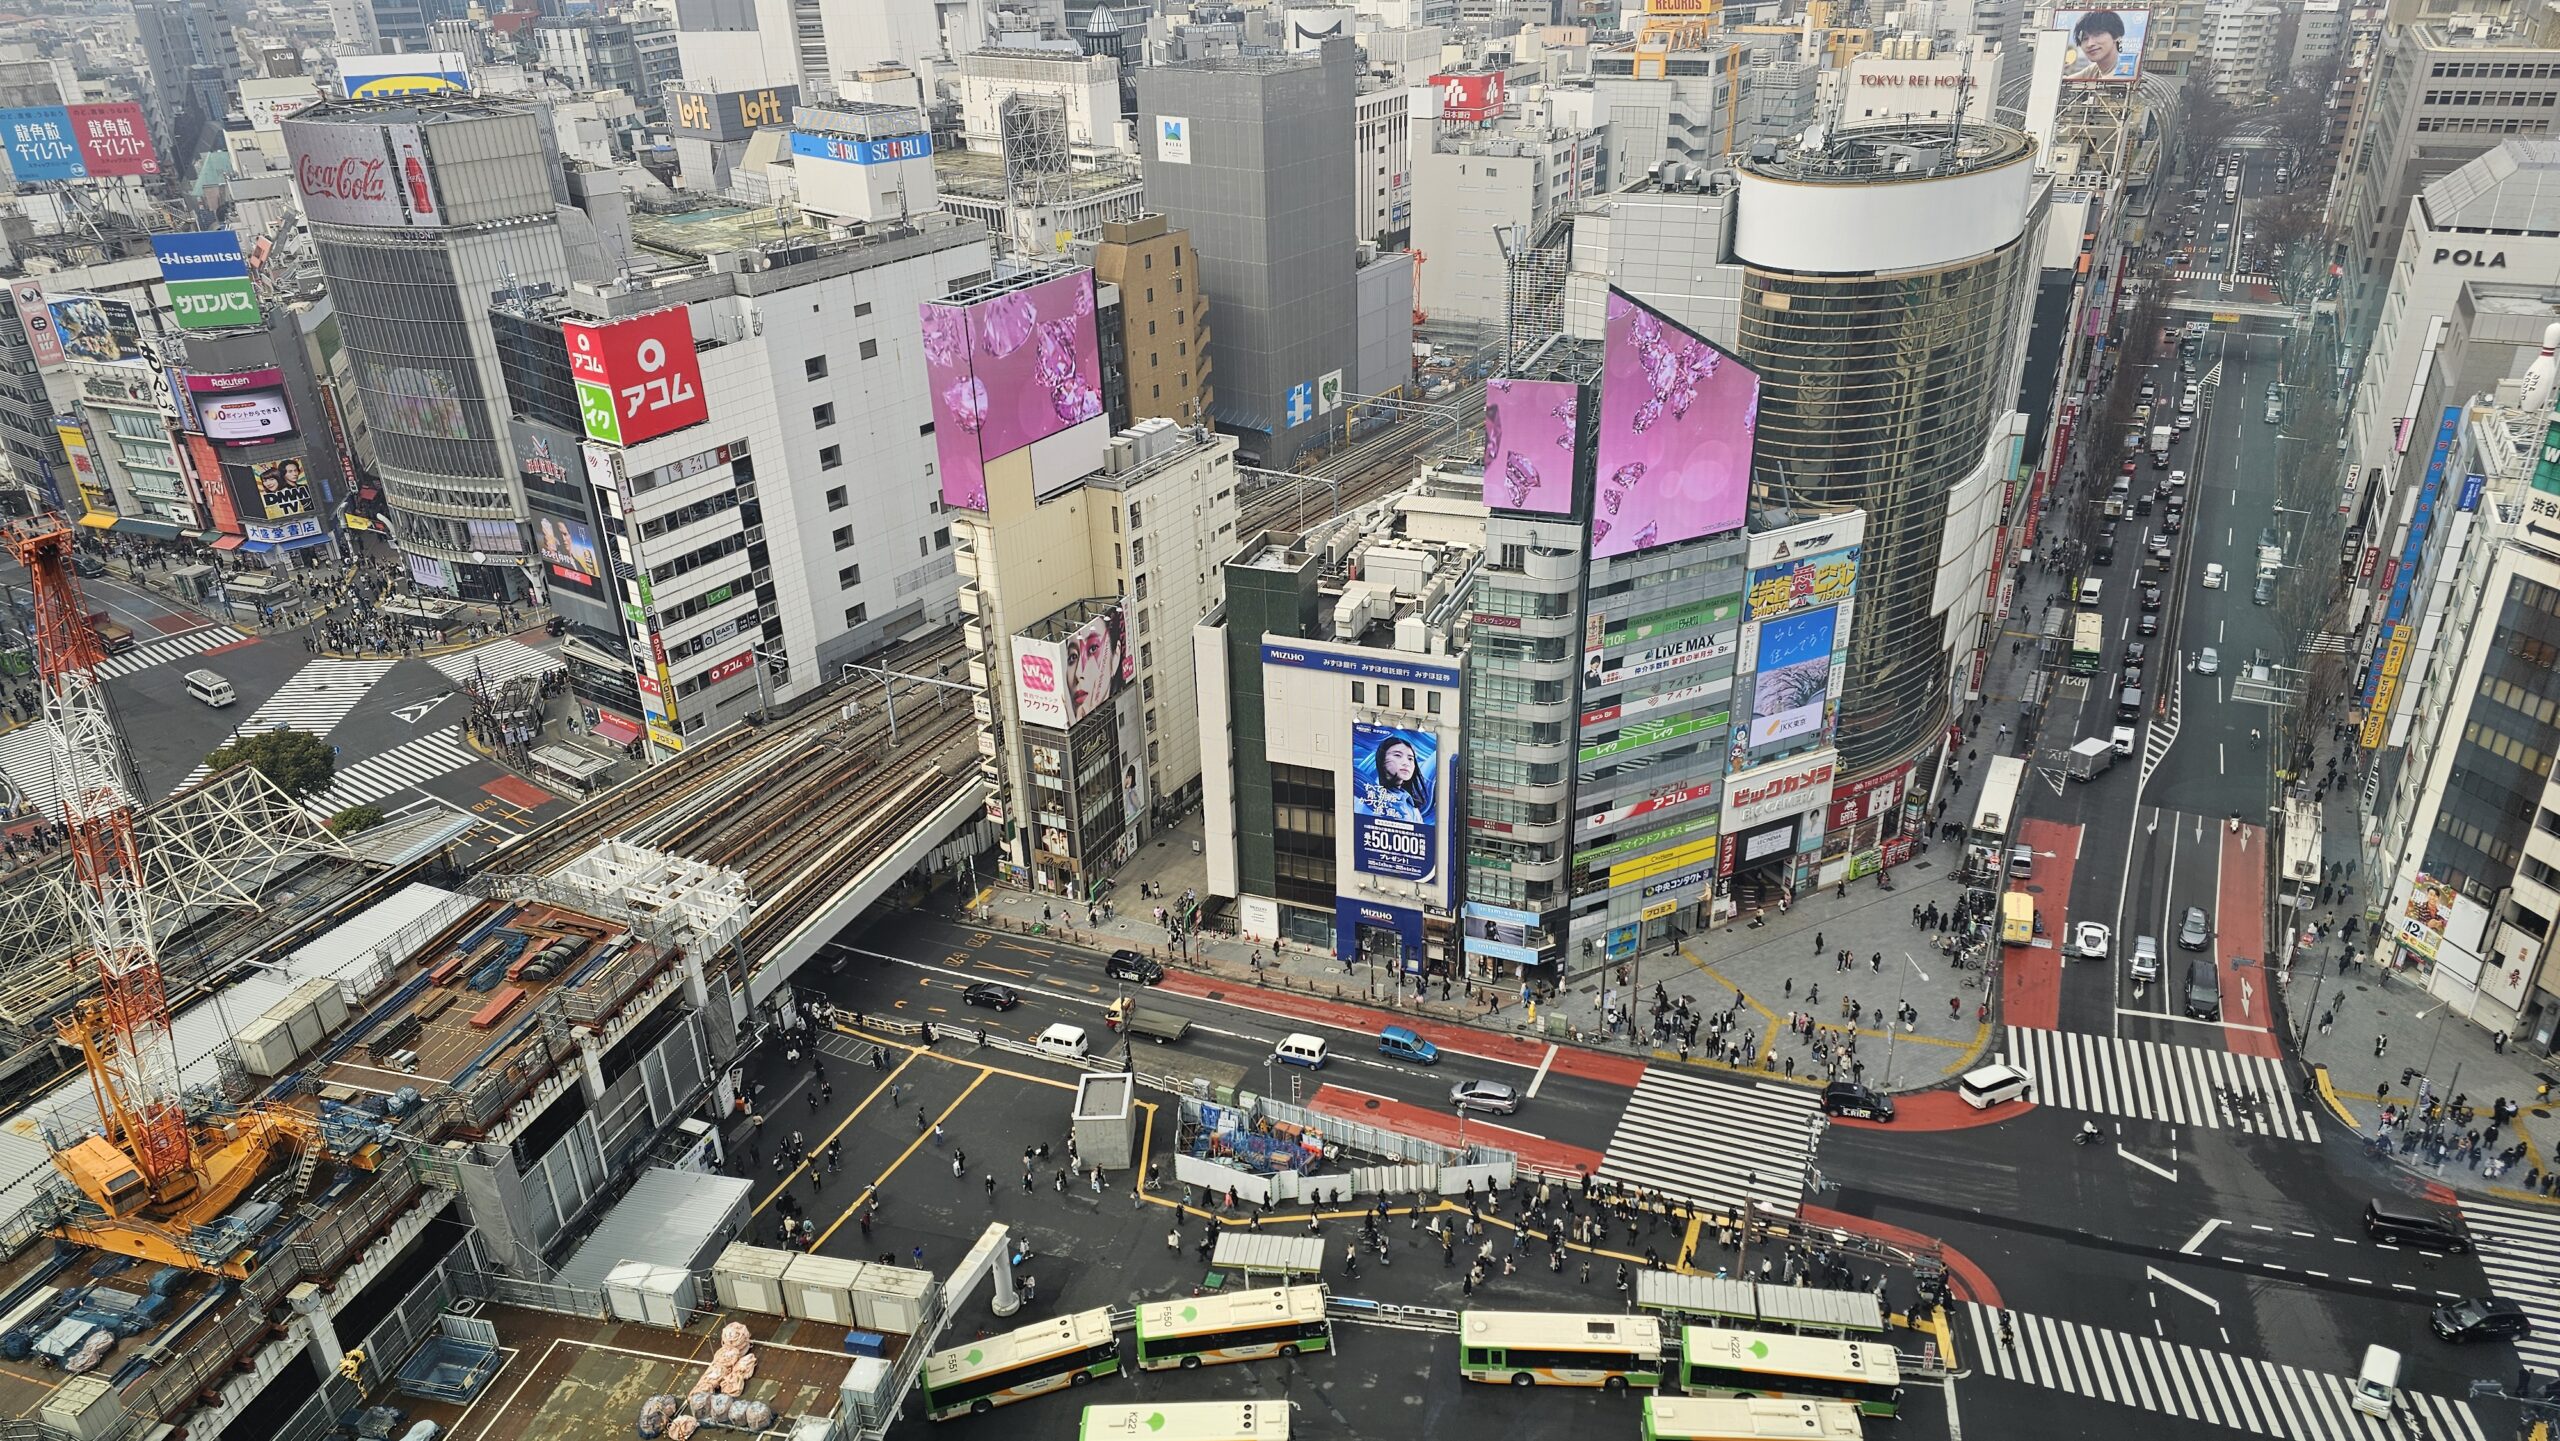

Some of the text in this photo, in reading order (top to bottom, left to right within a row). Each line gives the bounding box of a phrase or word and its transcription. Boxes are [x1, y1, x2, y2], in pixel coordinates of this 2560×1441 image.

[1859, 75, 1904, 86] TOKYU
[1908, 75, 1929, 87] REI
[14, 122, 61, 142] 龍角散
[87, 118, 134, 139] 龍角散
[827, 141, 859, 162] SEIBU
[872, 138, 921, 161] SEIBU
[159, 251, 243, 265] Hisamitsu
[2433, 248, 2506, 269] POLA
[176, 290, 254, 315] サロンパス
[572, 352, 604, 374] アコム
[211, 376, 250, 389] Rakuten
[621, 372, 695, 419] アコム
[580, 387, 610, 429] レイク
[263, 486, 309, 506] DMM
[280, 501, 300, 515] TV
[2531, 497, 2560, 520] 渋谷
[250, 520, 316, 540] 大盛堂書店
[710, 589, 726, 601] レイク
[1751, 603, 1789, 618] SHIBUYA
[715, 622, 734, 636] EAST
[1482, 617, 1519, 627] スヴェンソン
[1686, 634, 1715, 652] MAX
[722, 660, 743, 676] アコム
[1270, 650, 1451, 682] MIZUHO みずほ銀行 みずほ信託銀行 みずほ証券
[1023, 700, 1059, 714] ワクワク
[1652, 727, 1673, 740] レイク
[1779, 718, 1806, 732] JKK東京
[654, 733, 675, 746] プロミス
[1596, 743, 1617, 755] レイク
[1732, 764, 1833, 808] ビックカメラ
[1652, 785, 1710, 810] アコム 5F
[1840, 808, 1859, 822] GAME
[1371, 830, 1419, 855] 50,000
[1624, 827, 1684, 849] マインドフルネス
[1722, 834, 1734, 871] カラオケ
[1655, 873, 1702, 894] 中央コンタクト
[1360, 907, 1393, 920] MIZUHO
[1646, 904, 1673, 917] プロミス
[1163, 1306, 1173, 1327] F550
[1730, 1336, 1740, 1359] K222
[946, 1353, 958, 1373] F551
[1127, 1411, 1136, 1434] K221
